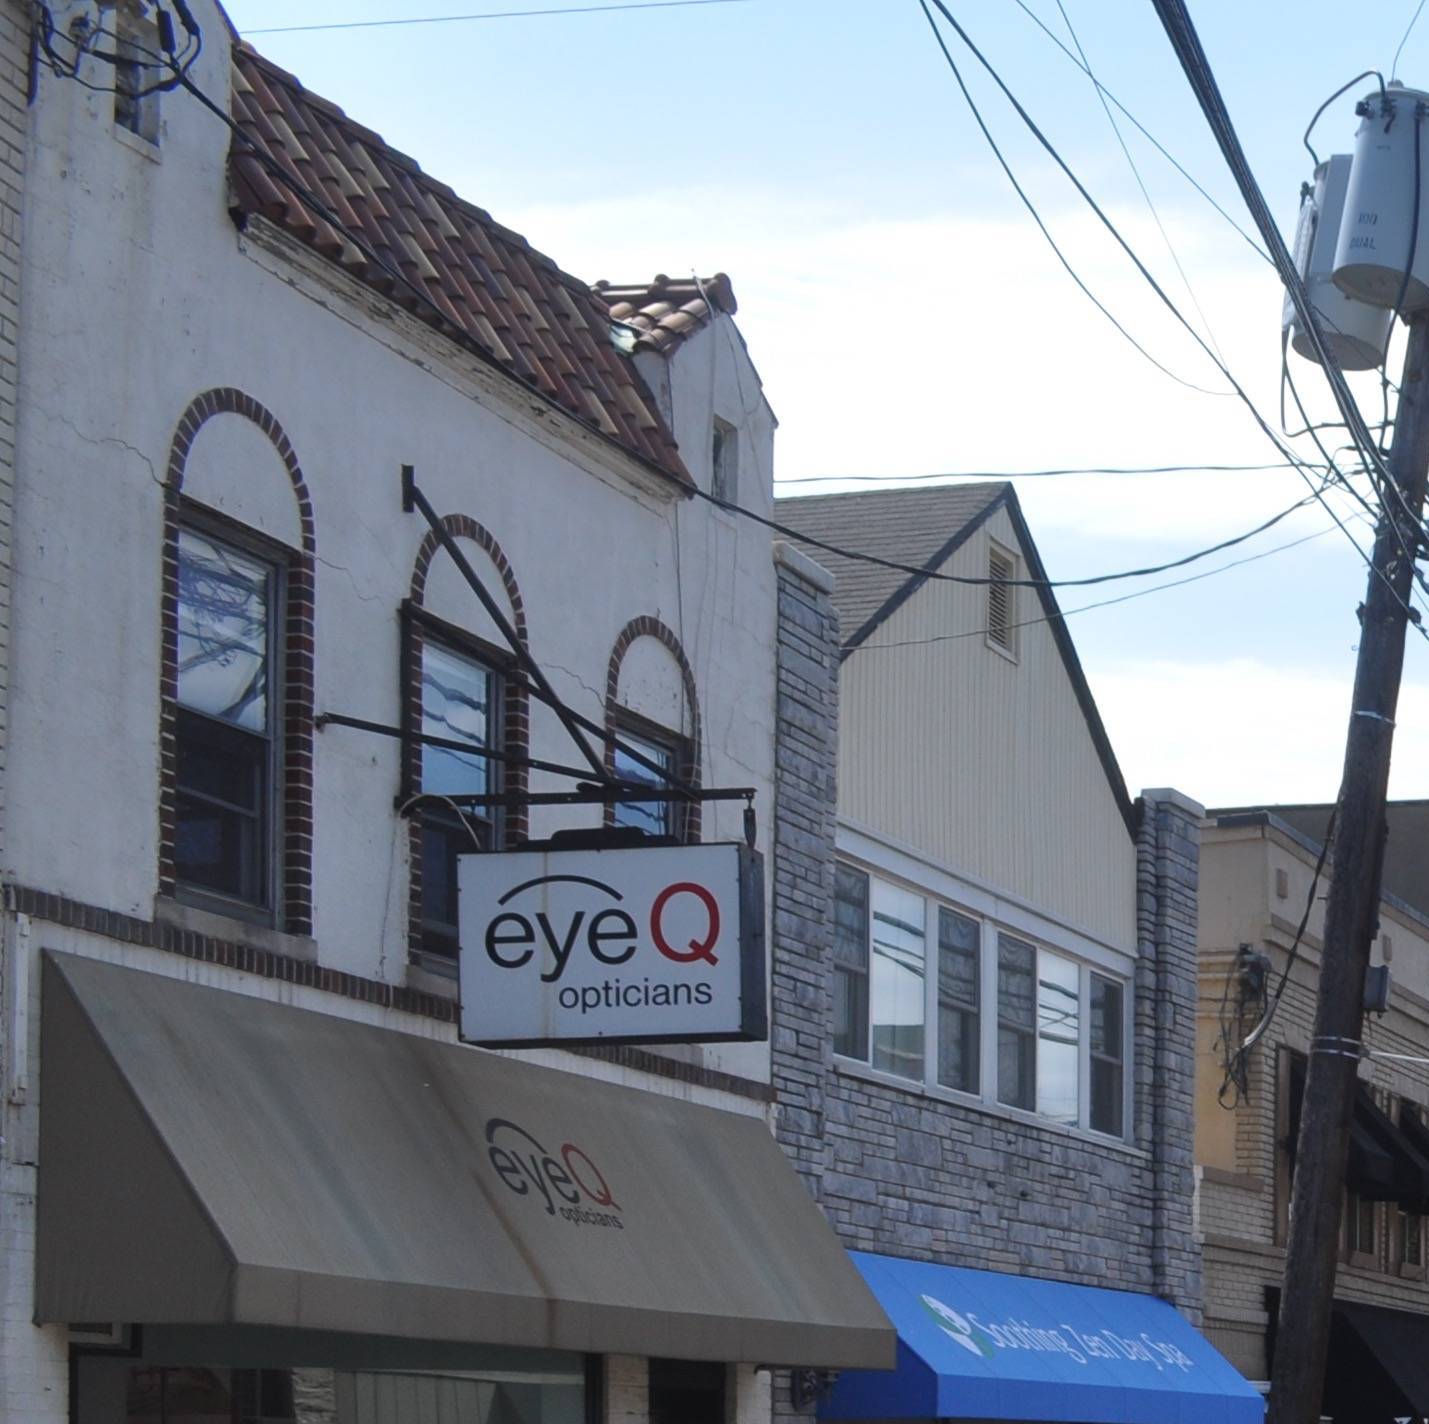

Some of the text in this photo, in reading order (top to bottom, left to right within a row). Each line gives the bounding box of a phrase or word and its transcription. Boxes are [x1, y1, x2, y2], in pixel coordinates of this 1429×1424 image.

[559, 977, 713, 1015] opticians
[559, 1205, 625, 1230] opticians
[967, 1312, 1194, 1373] Soothing Zen Day Spa
